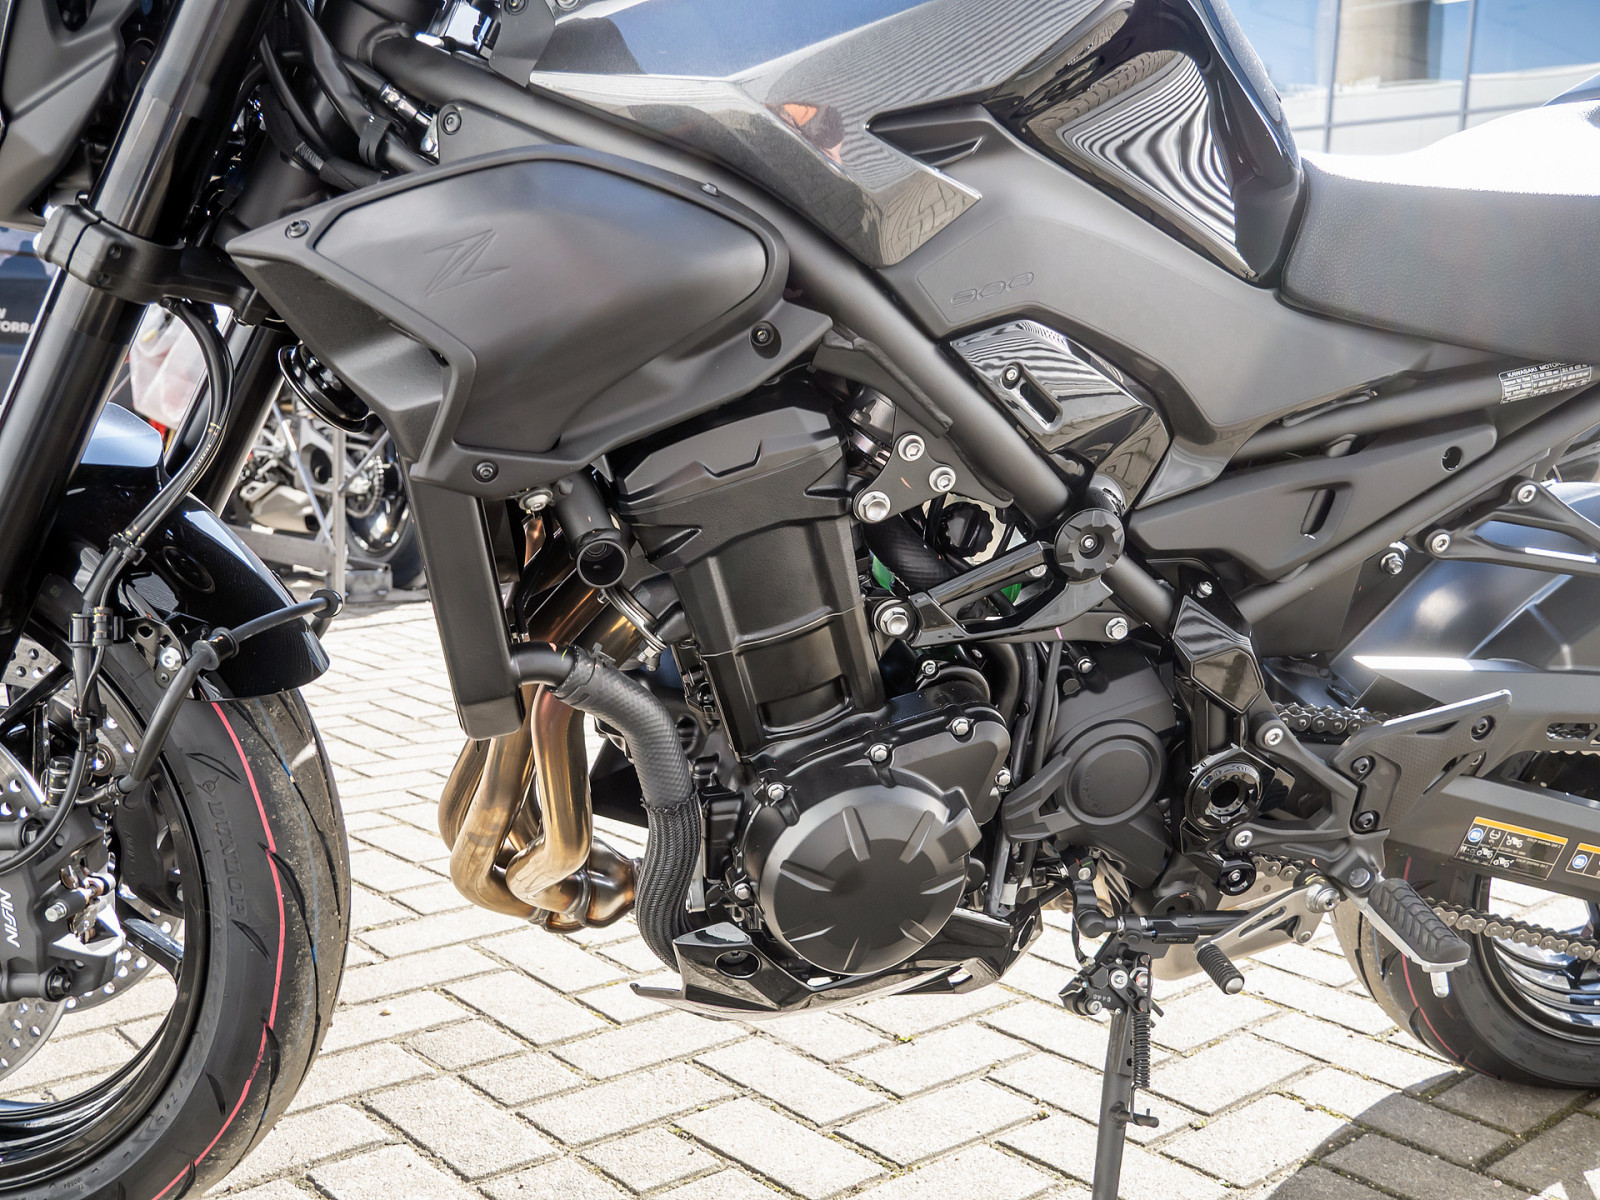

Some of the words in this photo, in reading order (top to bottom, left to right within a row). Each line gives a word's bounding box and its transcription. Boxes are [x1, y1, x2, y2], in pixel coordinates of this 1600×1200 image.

[951, 272, 1034, 308] 900
[1507, 367, 1538, 378] KAWASAKI
[207, 801, 247, 916] DUNLOP
[0, 887, 21, 948] NISSIN
